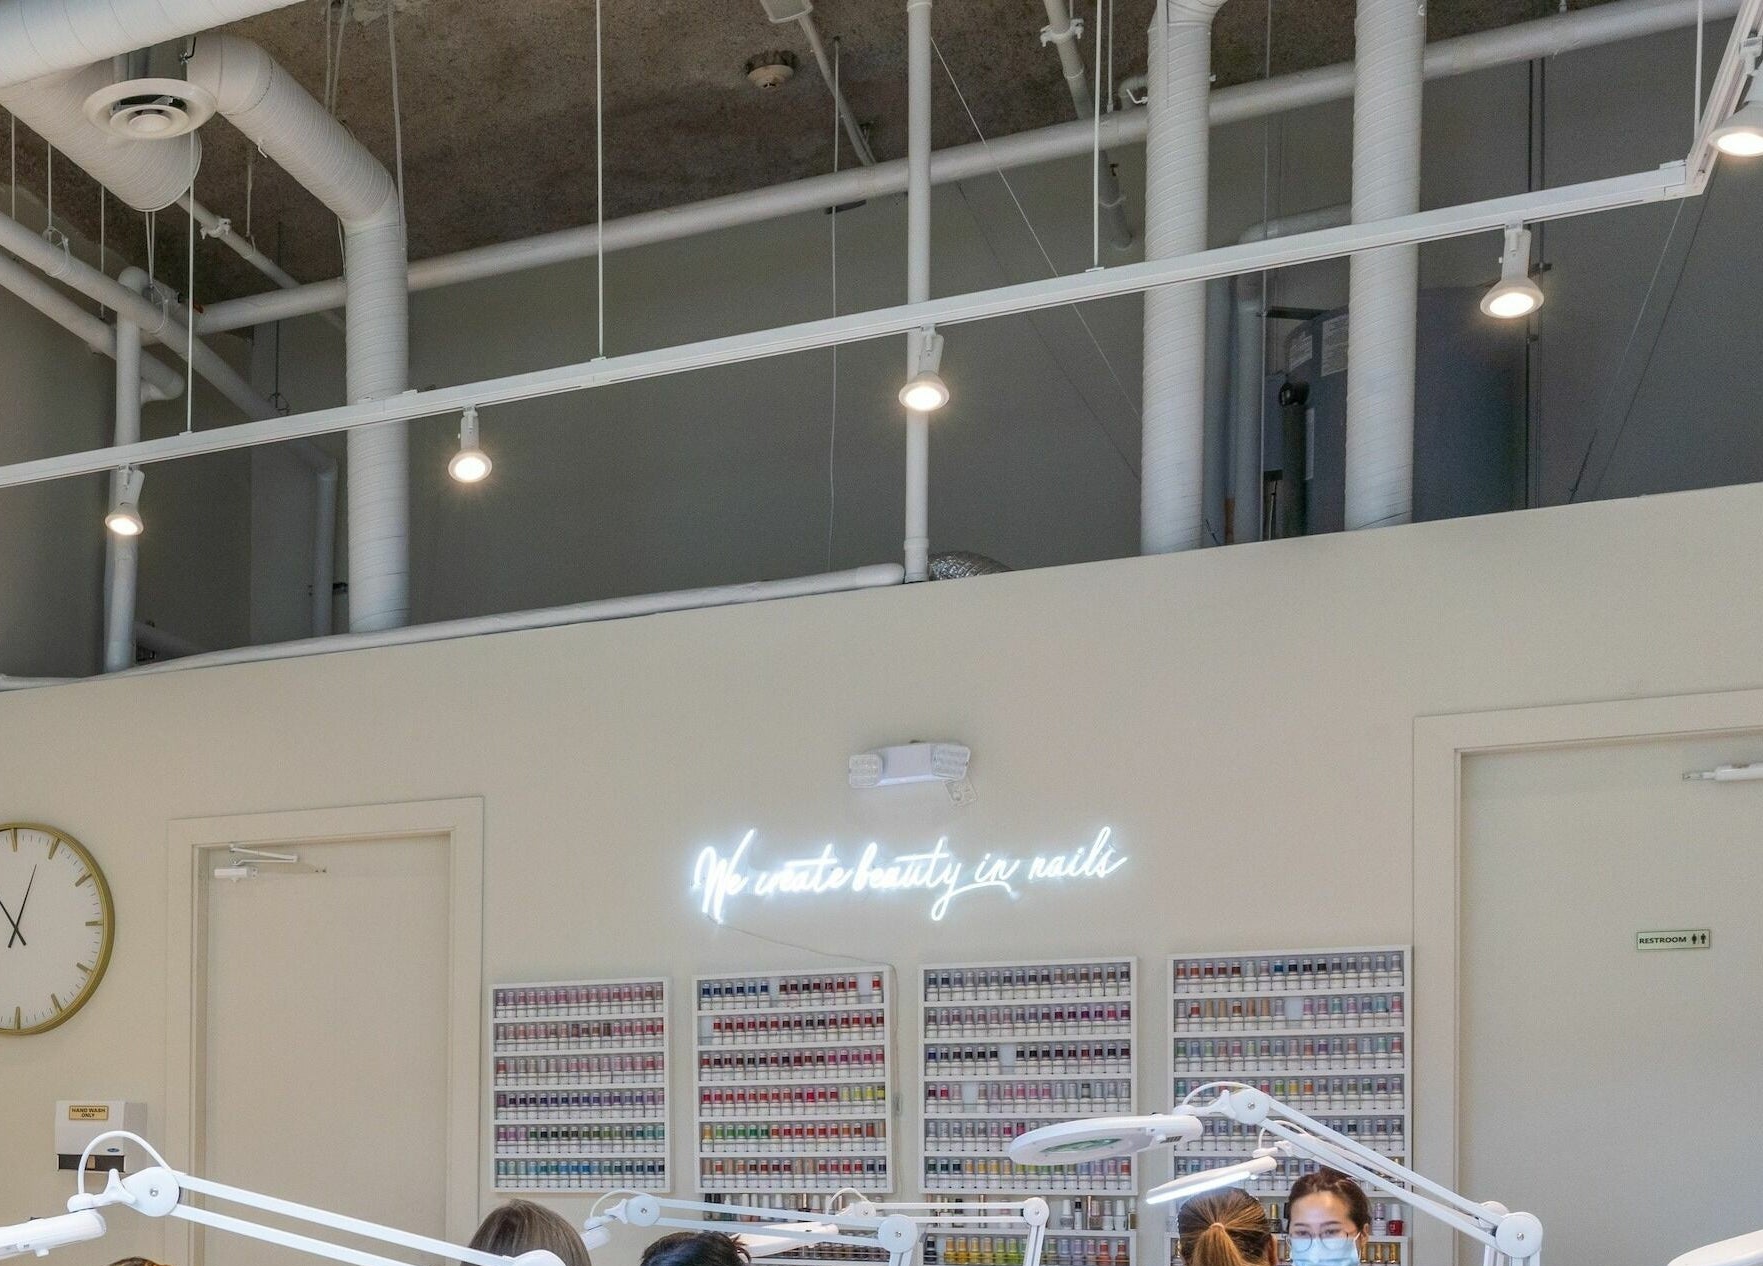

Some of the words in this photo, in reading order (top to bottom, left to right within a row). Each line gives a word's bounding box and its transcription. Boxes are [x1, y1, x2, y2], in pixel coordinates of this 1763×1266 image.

[691, 828, 757, 924] We
[755, 844, 853, 896] create
[852, 836, 1014, 921] beauty
[974, 852, 1022, 883] in
[1029, 825, 1129, 880] nails
[1639, 936, 1687, 944] RESTROOM
